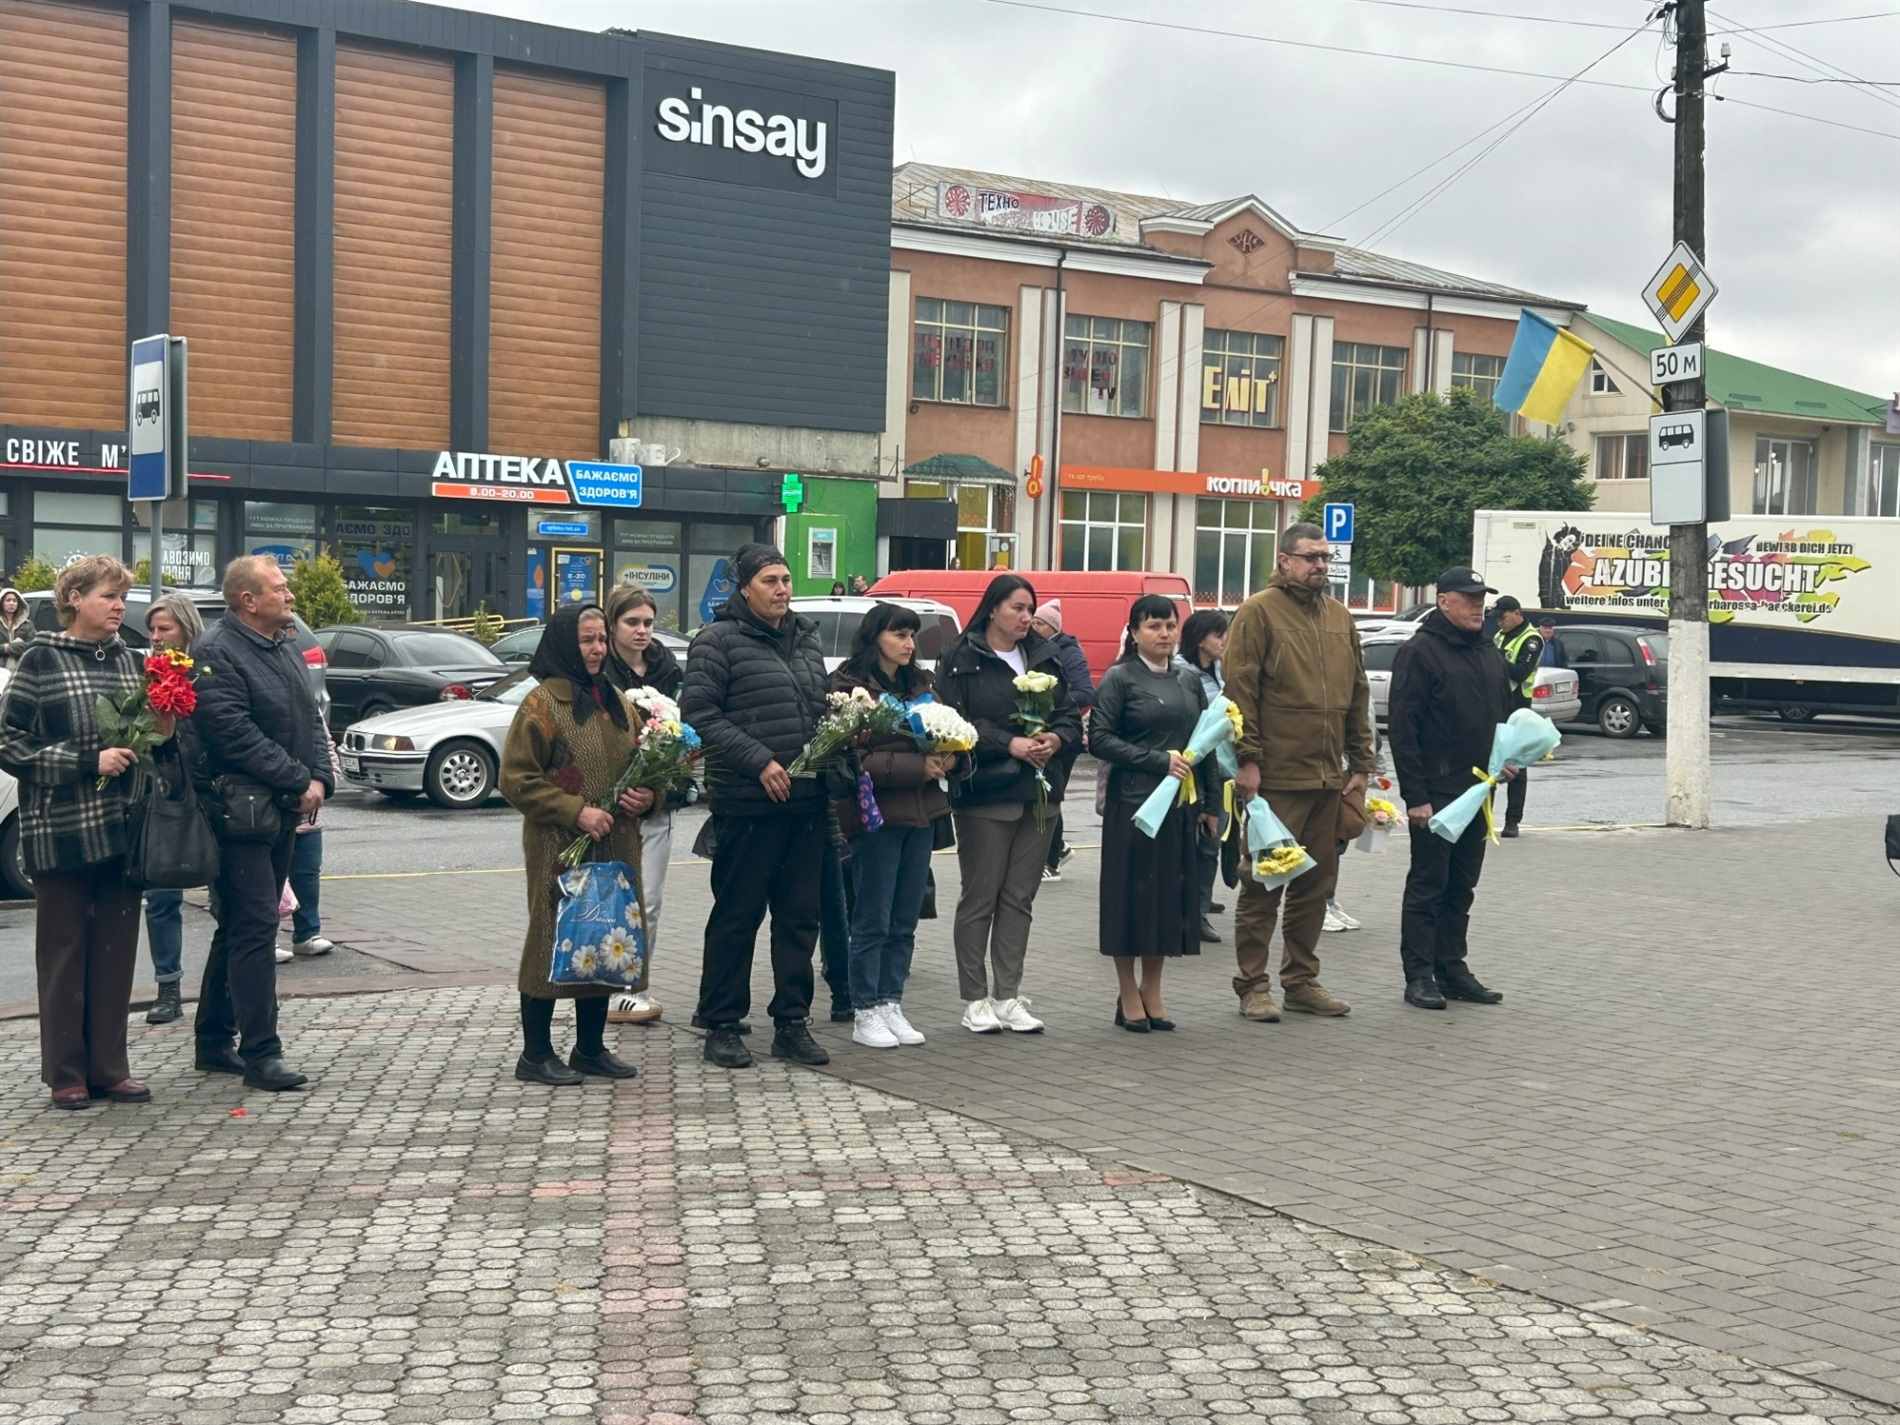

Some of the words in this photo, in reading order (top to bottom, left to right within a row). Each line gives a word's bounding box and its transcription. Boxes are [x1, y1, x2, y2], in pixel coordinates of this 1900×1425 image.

[657, 86, 827, 179] sinsay
[1656, 351, 1679, 378] 50
[6, 438, 80, 465] СВІЖЕ
[101, 443, 127, 468] М'
[432, 451, 566, 485] АПТЕКА
[575, 469, 638, 483] БАЖАЄМО
[578, 486, 637, 499] ЗДОРОВ'Я
[1332, 508, 1346, 538] P
[1585, 533, 1623, 548] DEINE
[1628, 534, 1670, 550] CHANC
[1756, 542, 1797, 554] BEWIRB
[1799, 543, 1825, 554] DICH
[162, 550, 210, 566] АВОЗИМО
[1592, 557, 1670, 588] AZUBI
[1565, 594, 1606, 607] weitere
[1636, 597, 1666, 608] unter
